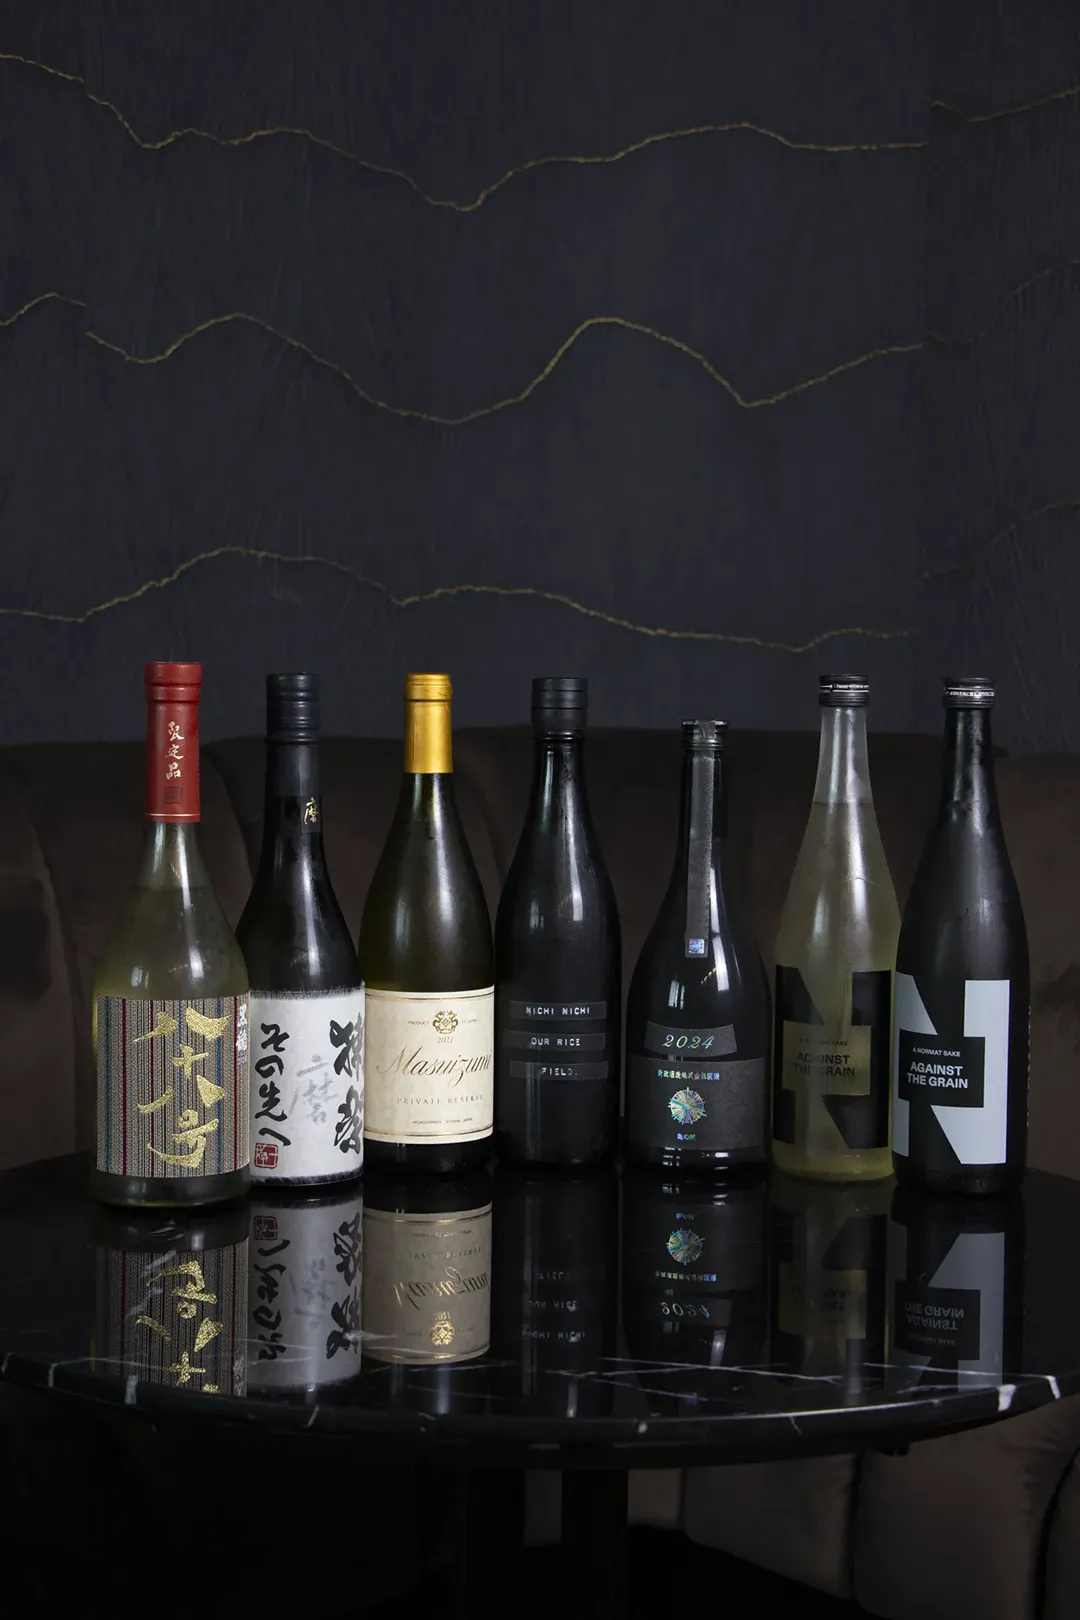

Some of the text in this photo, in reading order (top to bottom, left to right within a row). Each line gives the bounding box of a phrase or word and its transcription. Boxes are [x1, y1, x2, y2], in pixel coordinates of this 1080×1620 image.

[165, 721, 185, 780] 限定品
[526, 1007, 590, 1016] NICHI NICHI
[531, 1037, 580, 1046] OUR RICE
[662, 1034, 715, 1050] 2024
[917, 1047, 942, 1057] NORMAT
[943, 1050, 961, 1058] SAKE
[377, 1045, 492, 1089] Masuizumi
[910, 1061, 963, 1077] AGAINST
[132, 1007, 231, 1168] 八十八号
[255, 1022, 291, 1147] その先へ
[907, 1072, 968, 1090] THE GRAIN
[448, 1093, 483, 1104] RESERVE
